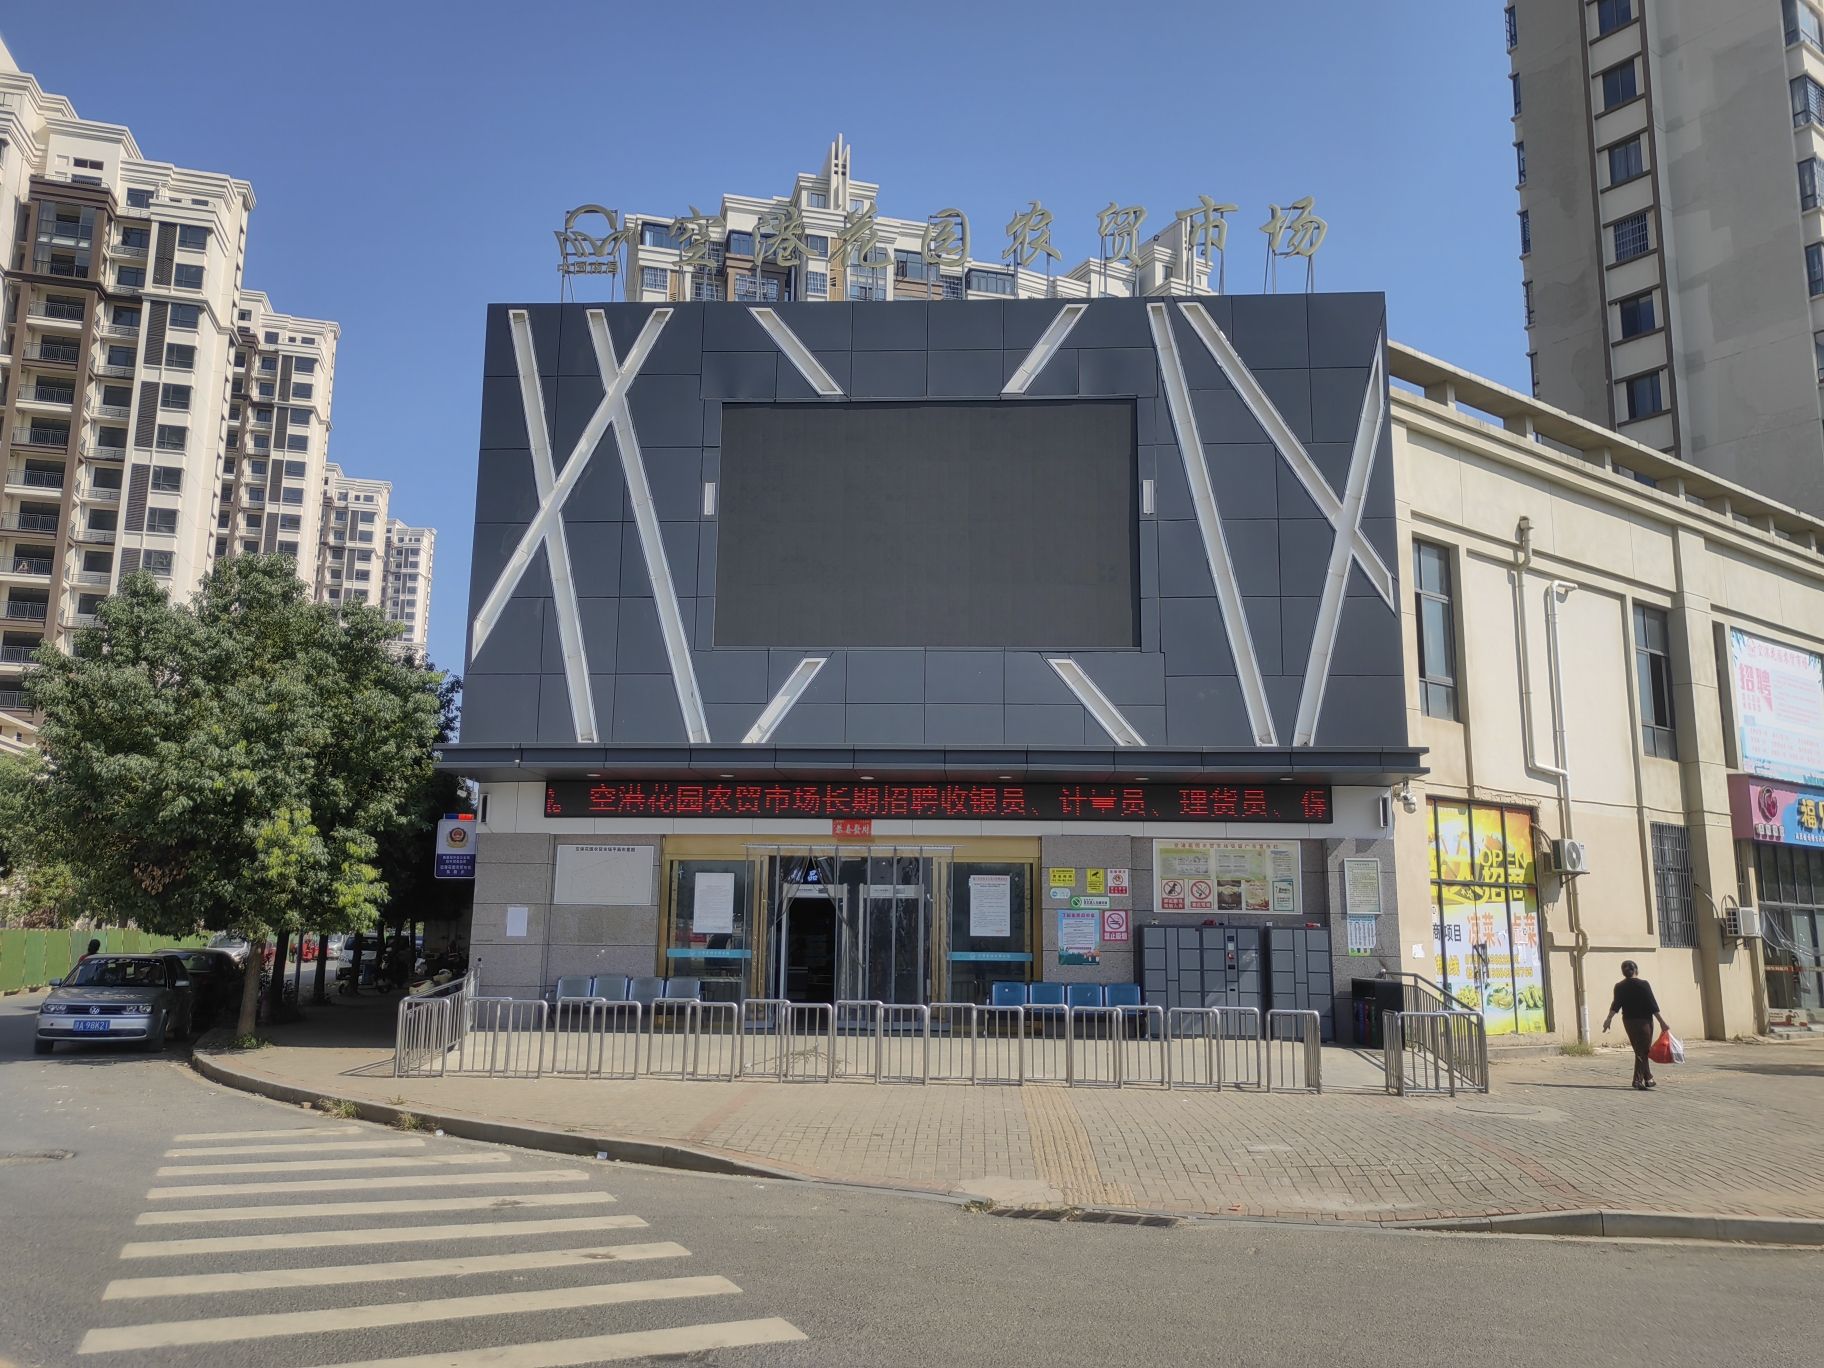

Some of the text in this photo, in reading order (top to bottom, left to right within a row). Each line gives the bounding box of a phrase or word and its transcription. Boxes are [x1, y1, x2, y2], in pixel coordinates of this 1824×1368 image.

[669, 194, 1328, 268] 空港花园农贸市场
[1739, 663, 1772, 697] 招聘
[1480, 848, 1527, 869] OPEN
